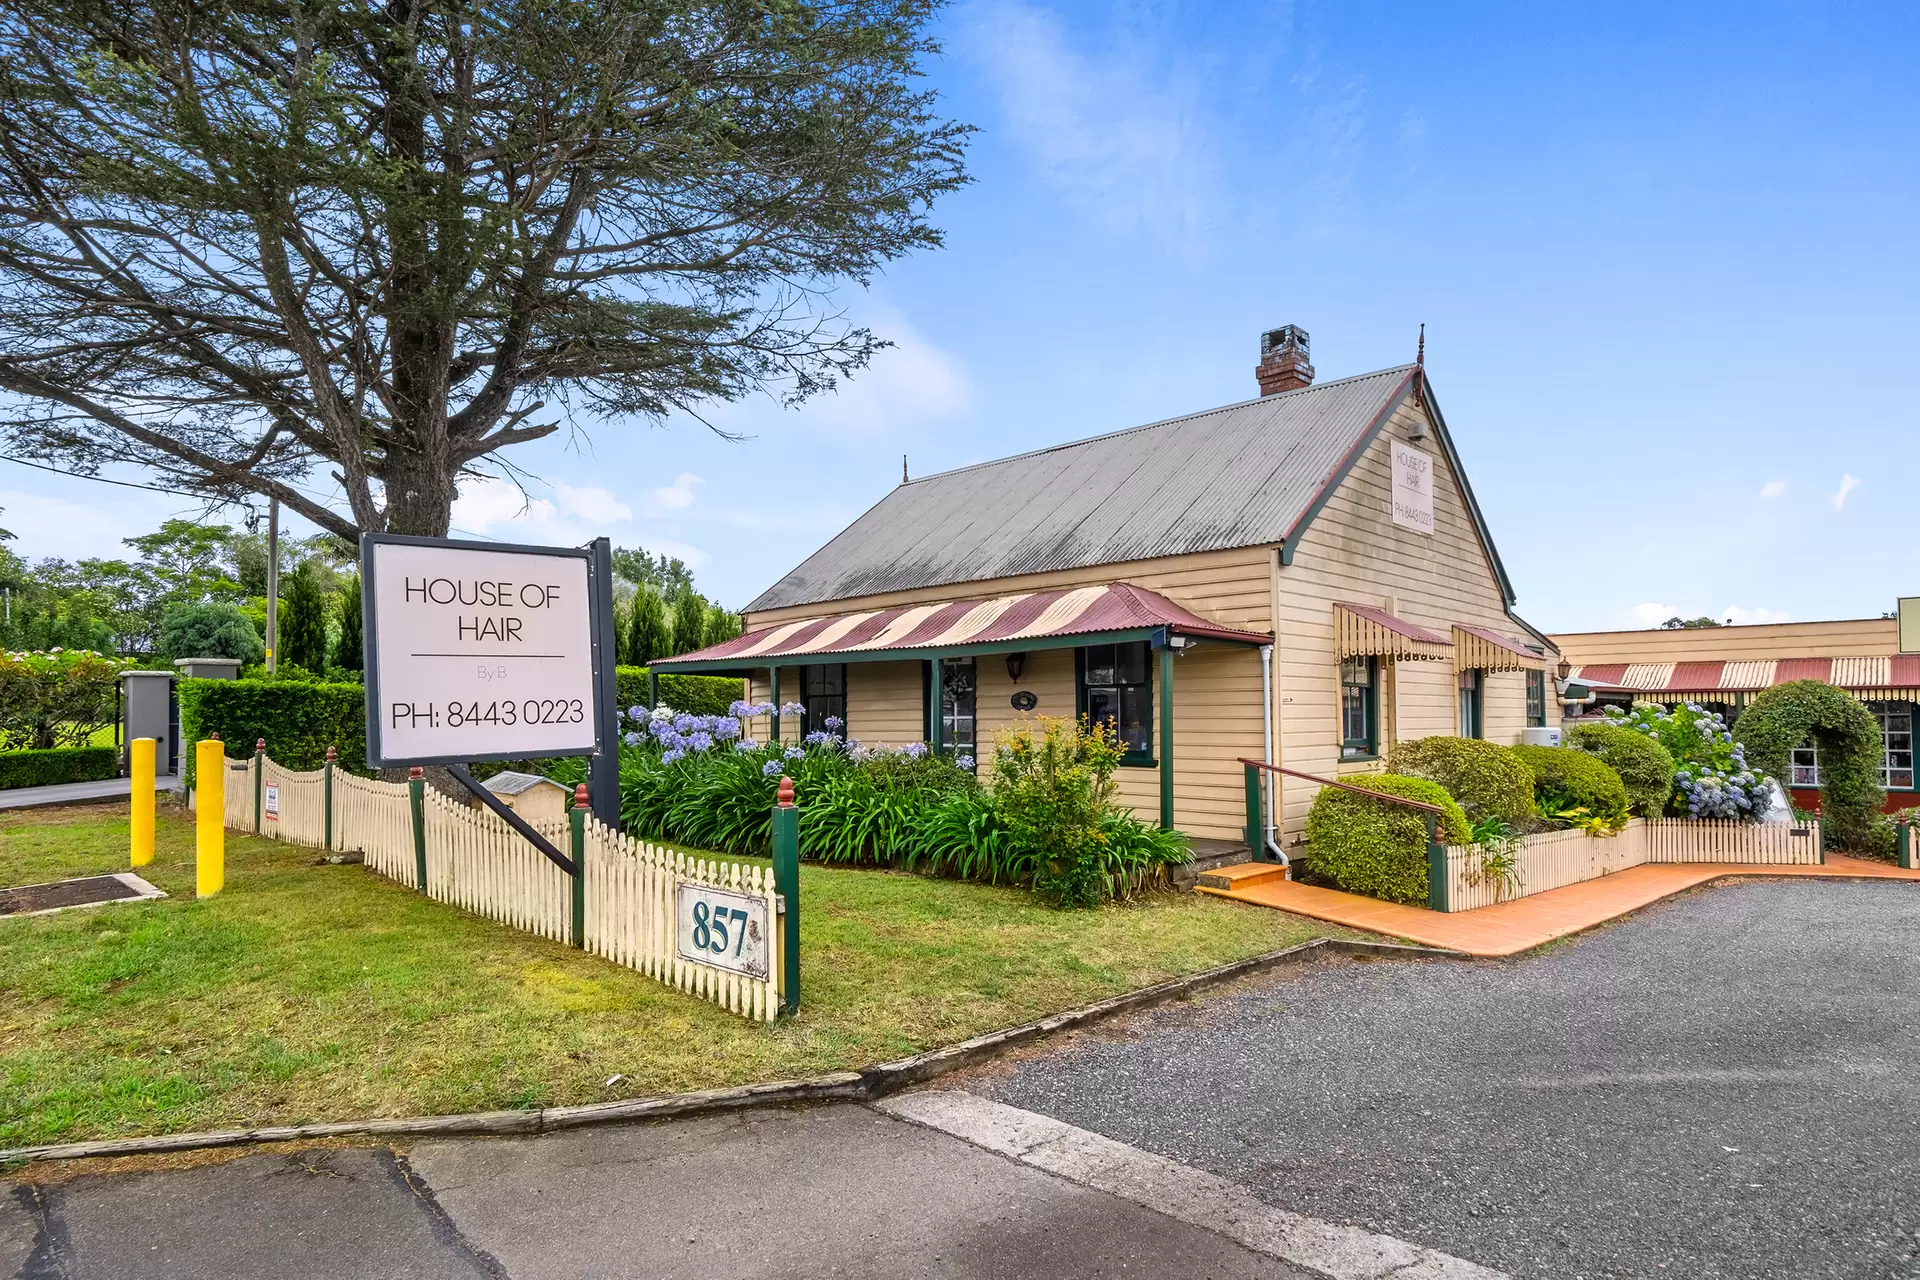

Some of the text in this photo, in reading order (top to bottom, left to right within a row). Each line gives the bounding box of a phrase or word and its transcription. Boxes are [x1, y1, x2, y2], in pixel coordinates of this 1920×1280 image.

[1396, 450, 1427, 474] HOUSE OF
[405, 577, 561, 609] HOUSE OF
[458, 616, 523, 642] HAIR
[477, 666, 507, 682] By B
[392, 699, 585, 729] PH: 8443 0223
[692, 901, 748, 958] 857
